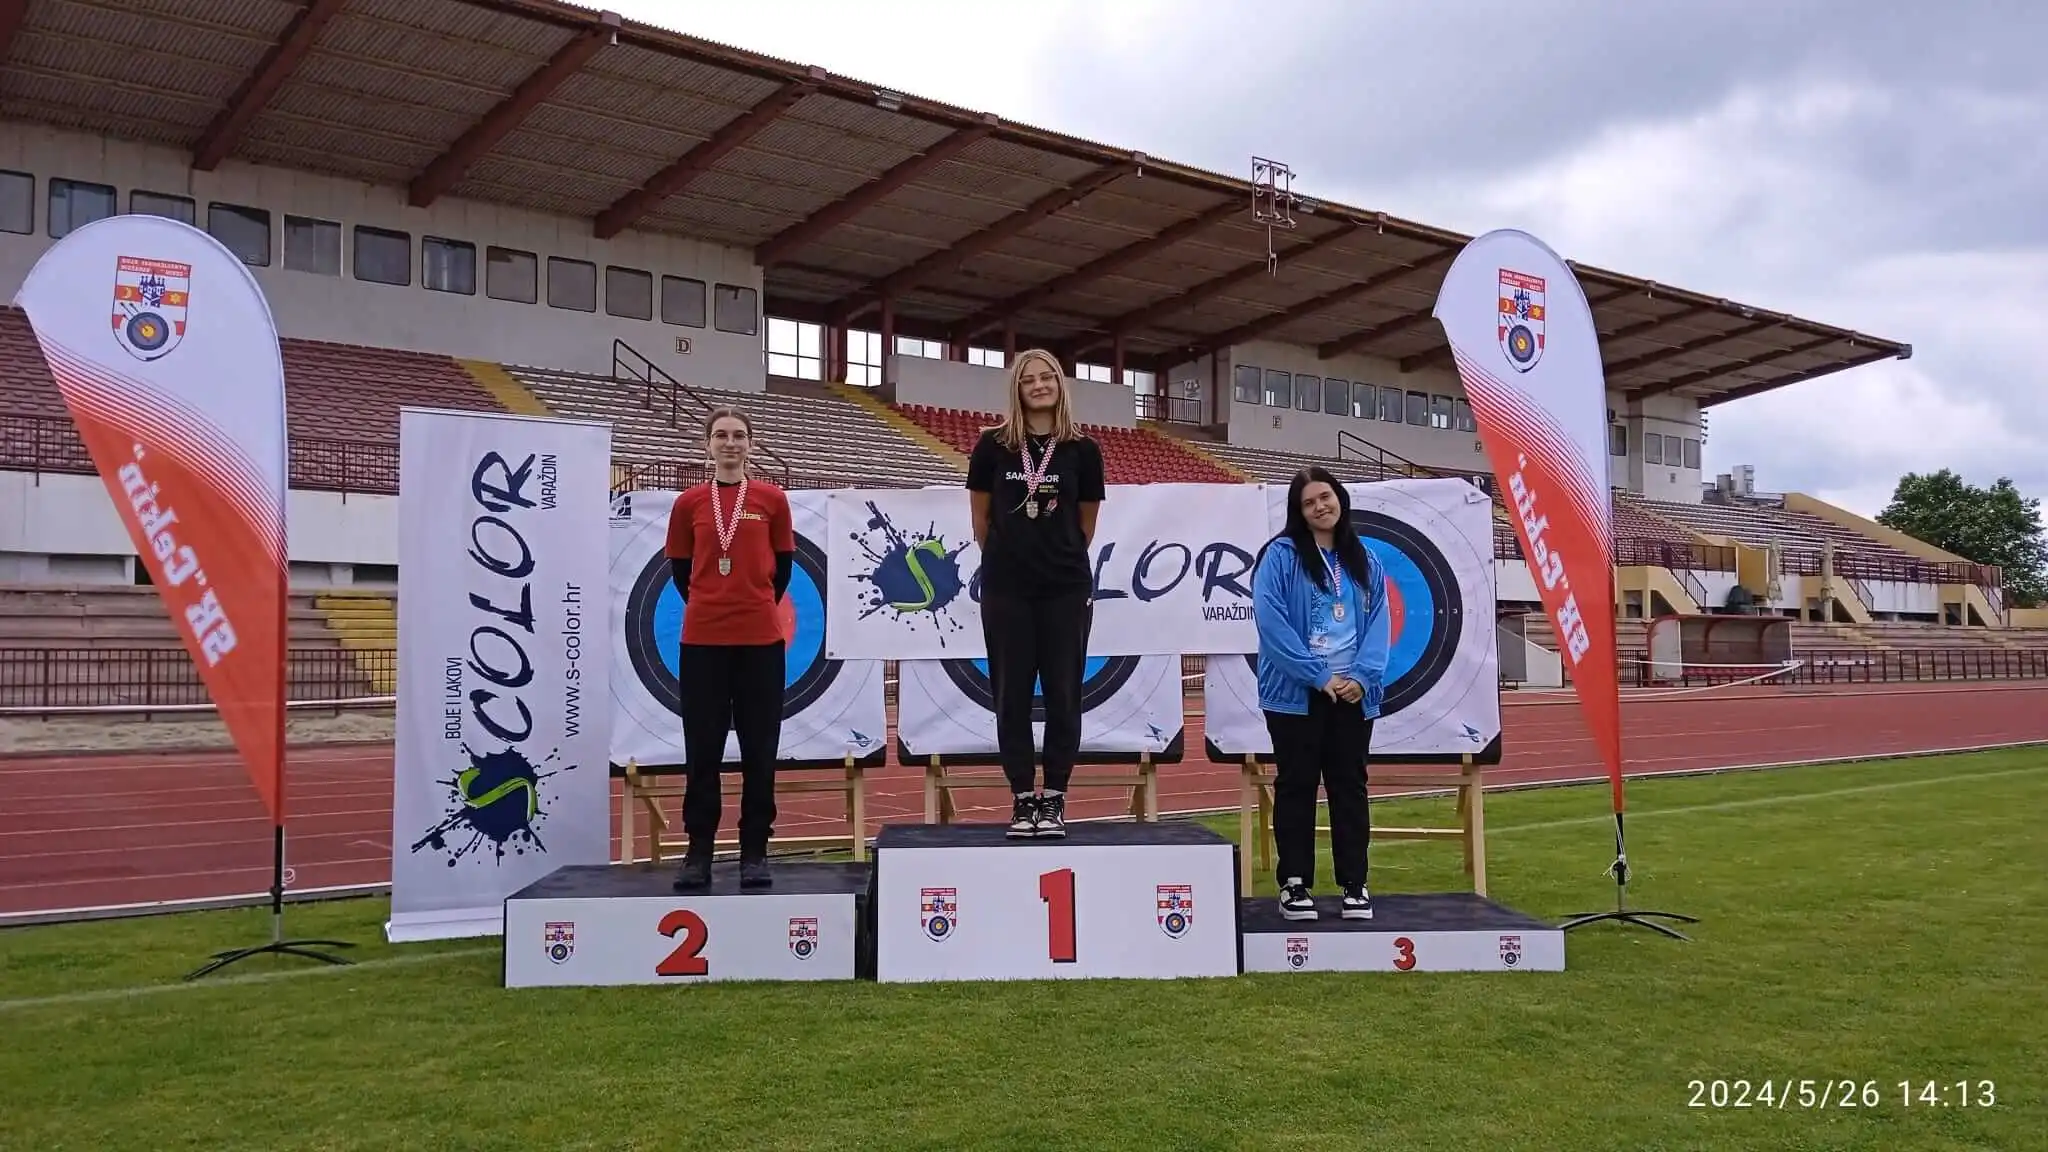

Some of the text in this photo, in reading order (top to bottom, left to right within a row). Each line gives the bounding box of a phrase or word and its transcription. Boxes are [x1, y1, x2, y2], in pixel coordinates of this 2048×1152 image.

[679, 339, 689, 352] D
[537, 454, 557, 510] VARAŽDIN
[467, 451, 537, 743] COLOR
[968, 540, 1255, 603] LOR
[446, 657, 463, 698] LAKOVI
[561, 582, 582, 738] www.s-color.hr
[445, 708, 462, 739] BOJE
[656, 909, 709, 977] 2
[1039, 868, 1077, 963] 1
[1392, 936, 1417, 971] 3
